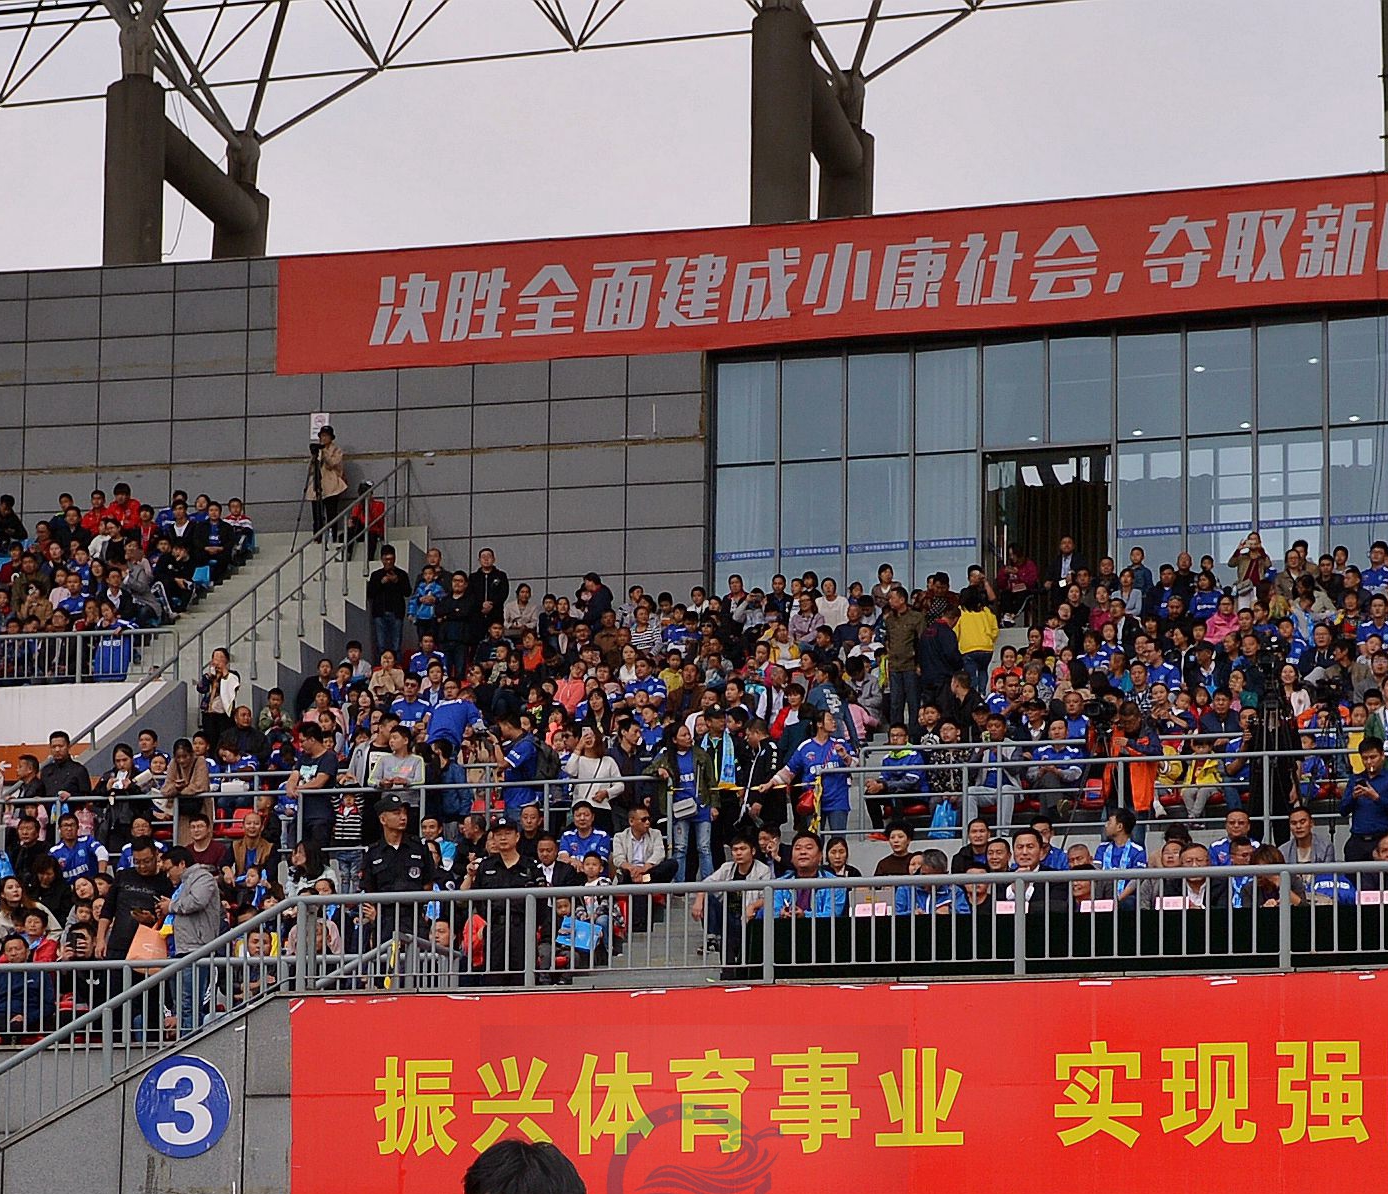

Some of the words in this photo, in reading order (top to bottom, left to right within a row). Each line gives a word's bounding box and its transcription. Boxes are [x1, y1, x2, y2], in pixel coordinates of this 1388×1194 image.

[156, 1065, 213, 1146] 3
[373, 1045, 965, 1157] 振兴体育事业
